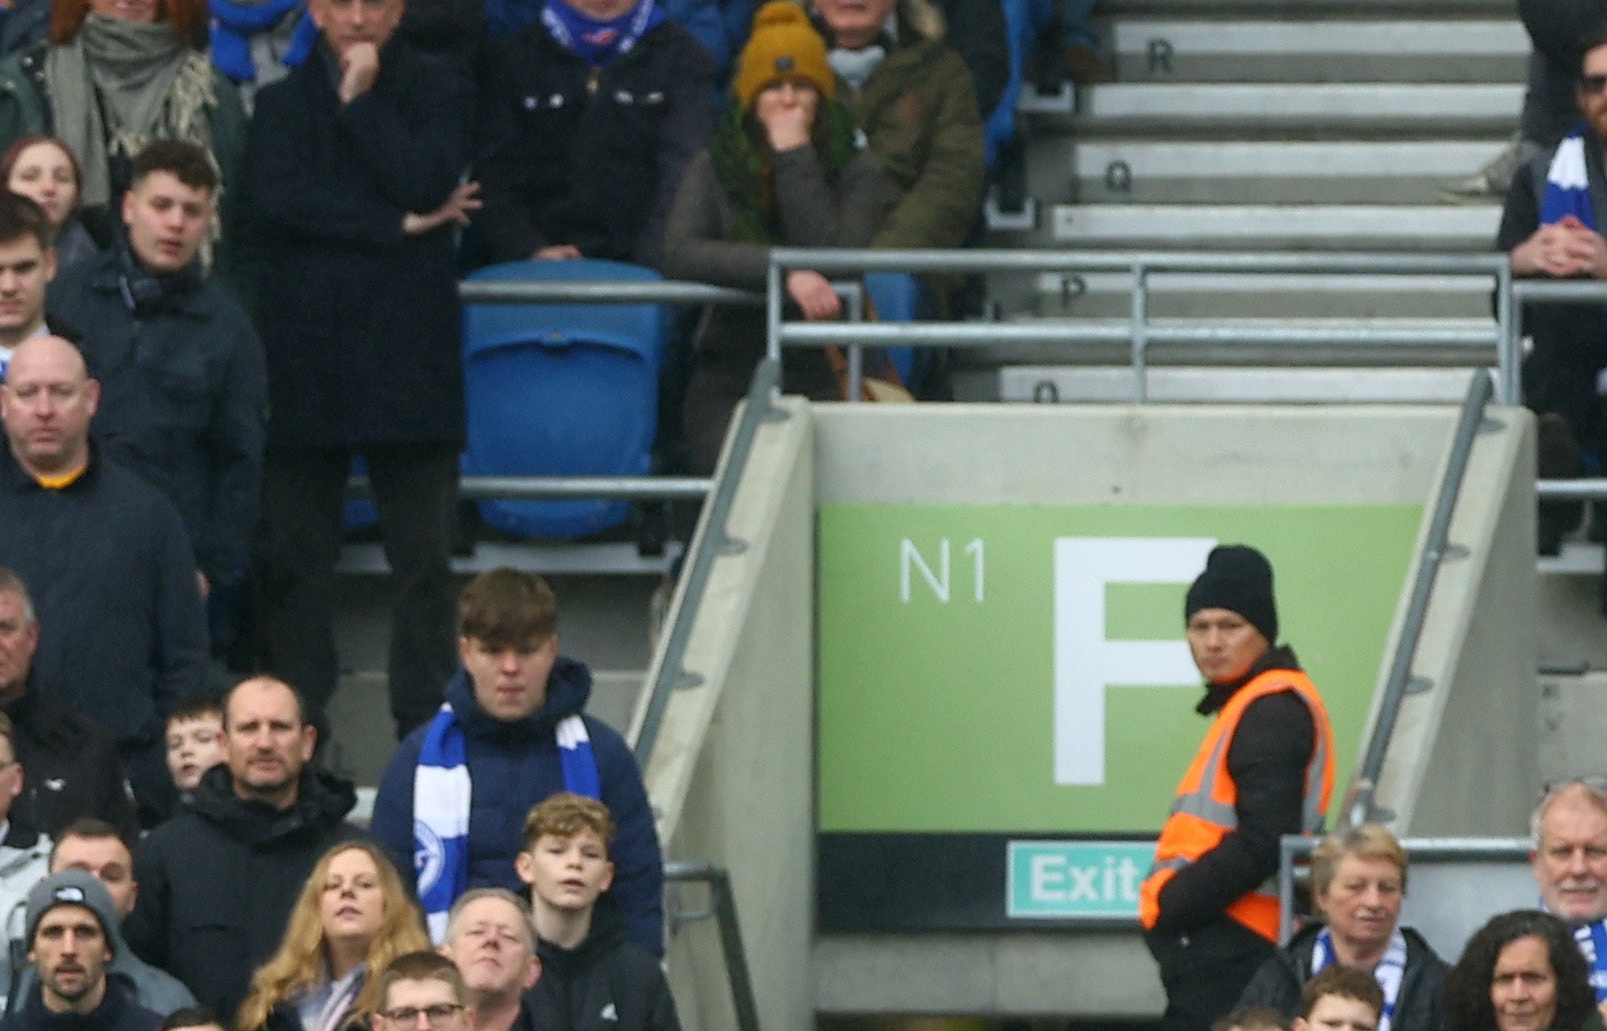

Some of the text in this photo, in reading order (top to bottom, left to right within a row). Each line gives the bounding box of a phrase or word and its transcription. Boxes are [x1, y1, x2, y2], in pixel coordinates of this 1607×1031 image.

[1147, 38, 1174, 72] R
[1061, 272, 1087, 308] P
[899, 537, 986, 604] N1
[1053, 536, 1219, 786] F
[1030, 854, 1140, 902] Exit
